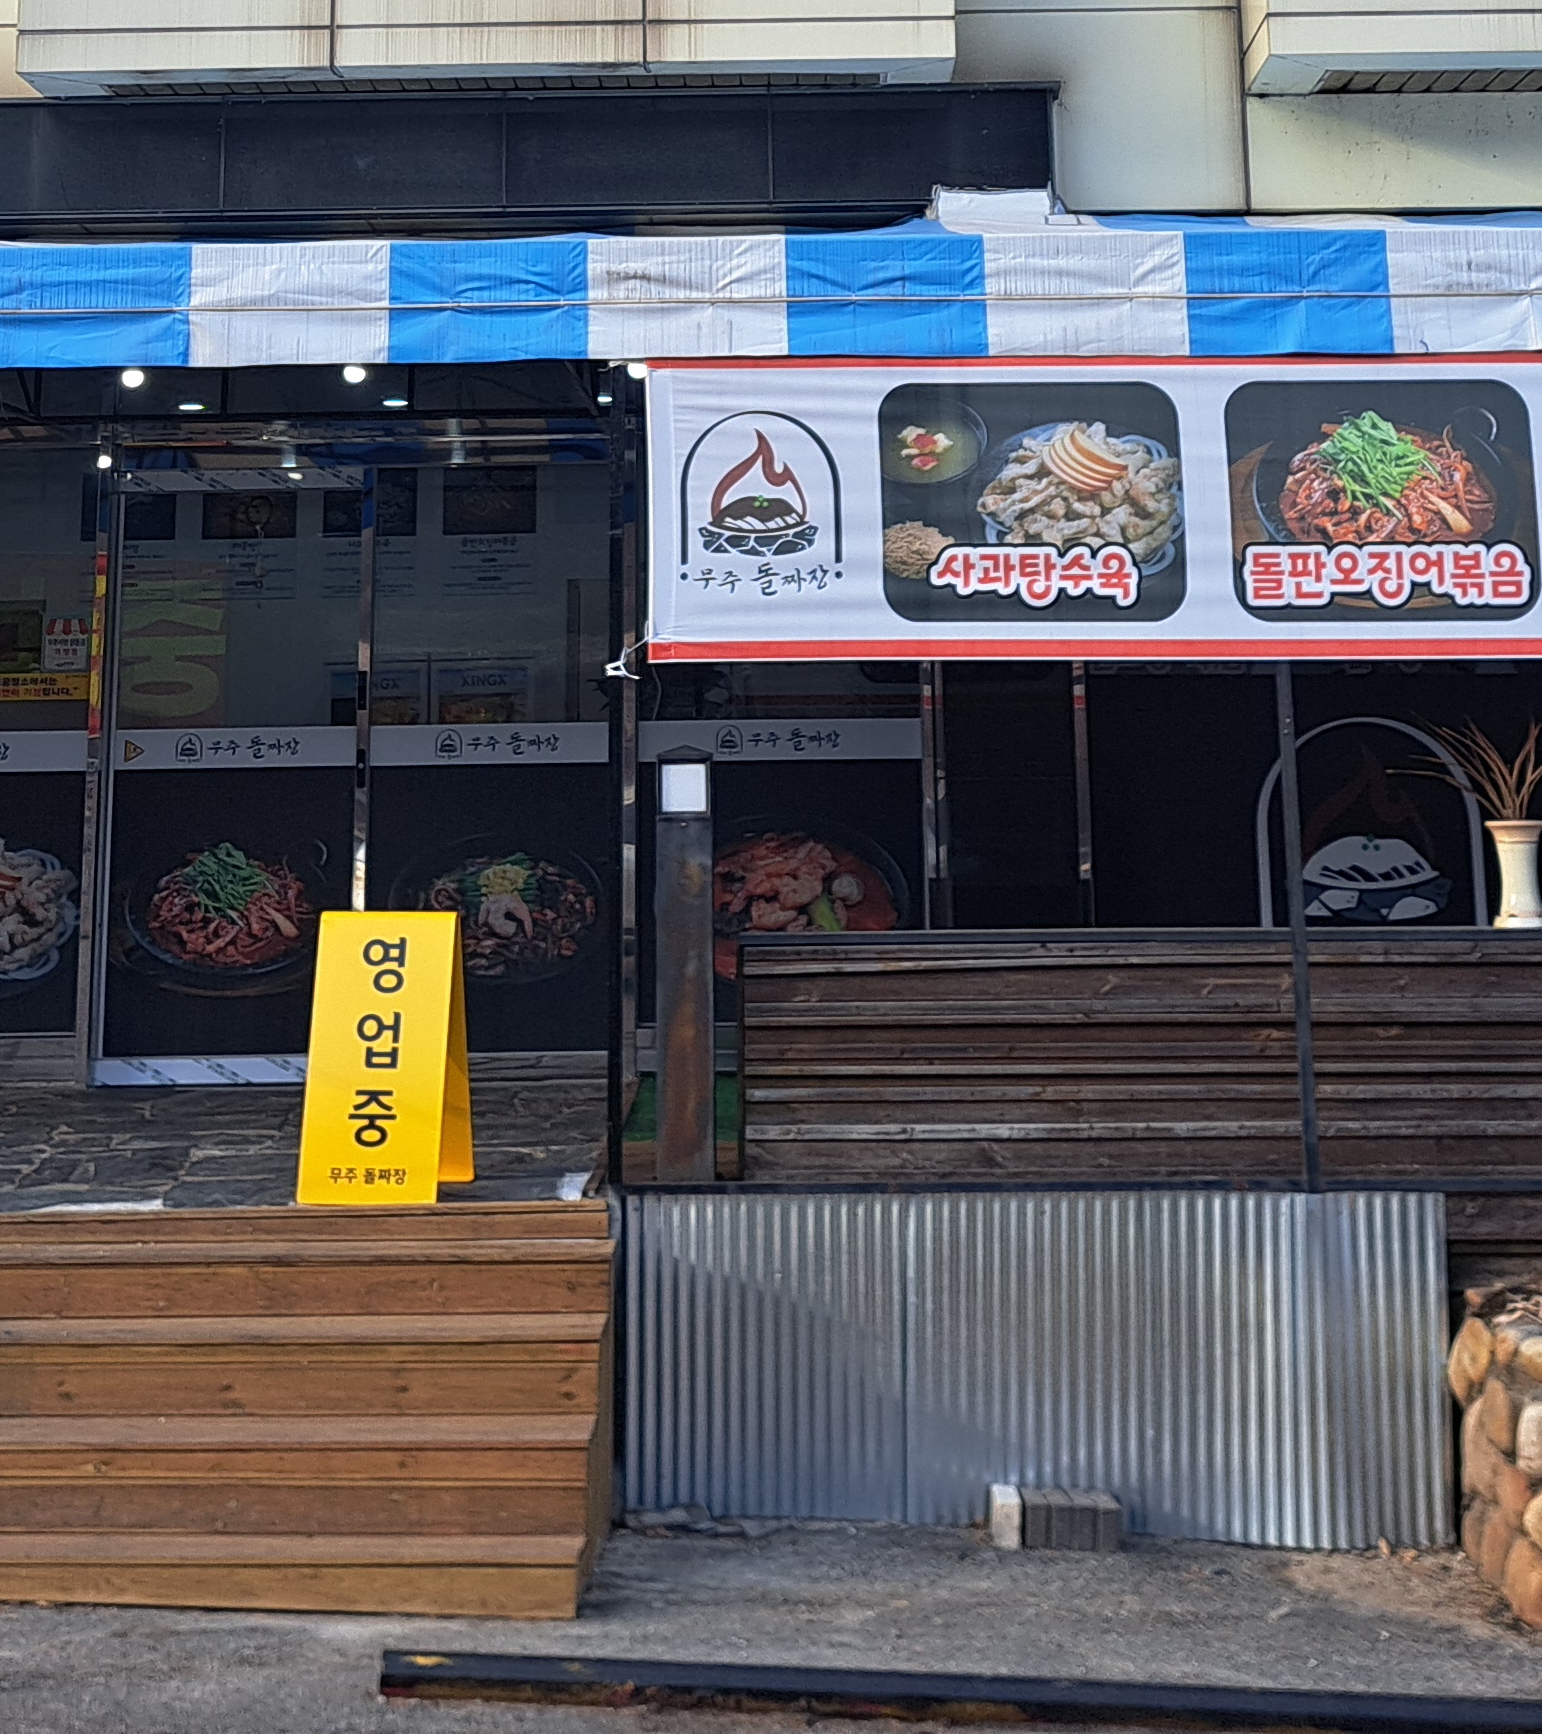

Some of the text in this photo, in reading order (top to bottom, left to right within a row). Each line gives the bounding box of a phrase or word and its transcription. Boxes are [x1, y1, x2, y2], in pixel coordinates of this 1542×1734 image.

[692, 562, 830, 596] 무주 돌짜장
[935, 550, 1134, 602] 사과탕수육
[1249, 549, 1528, 601] 돌판오징어볶음
[207, 735, 301, 759] 무주 돌짜장
[467, 731, 560, 755] 무주 돌짜장
[747, 727, 841, 752] 무주 돌짜장
[348, 936, 408, 1148] 영업중
[329, 1167, 407, 1185] 무주 돌짜장
